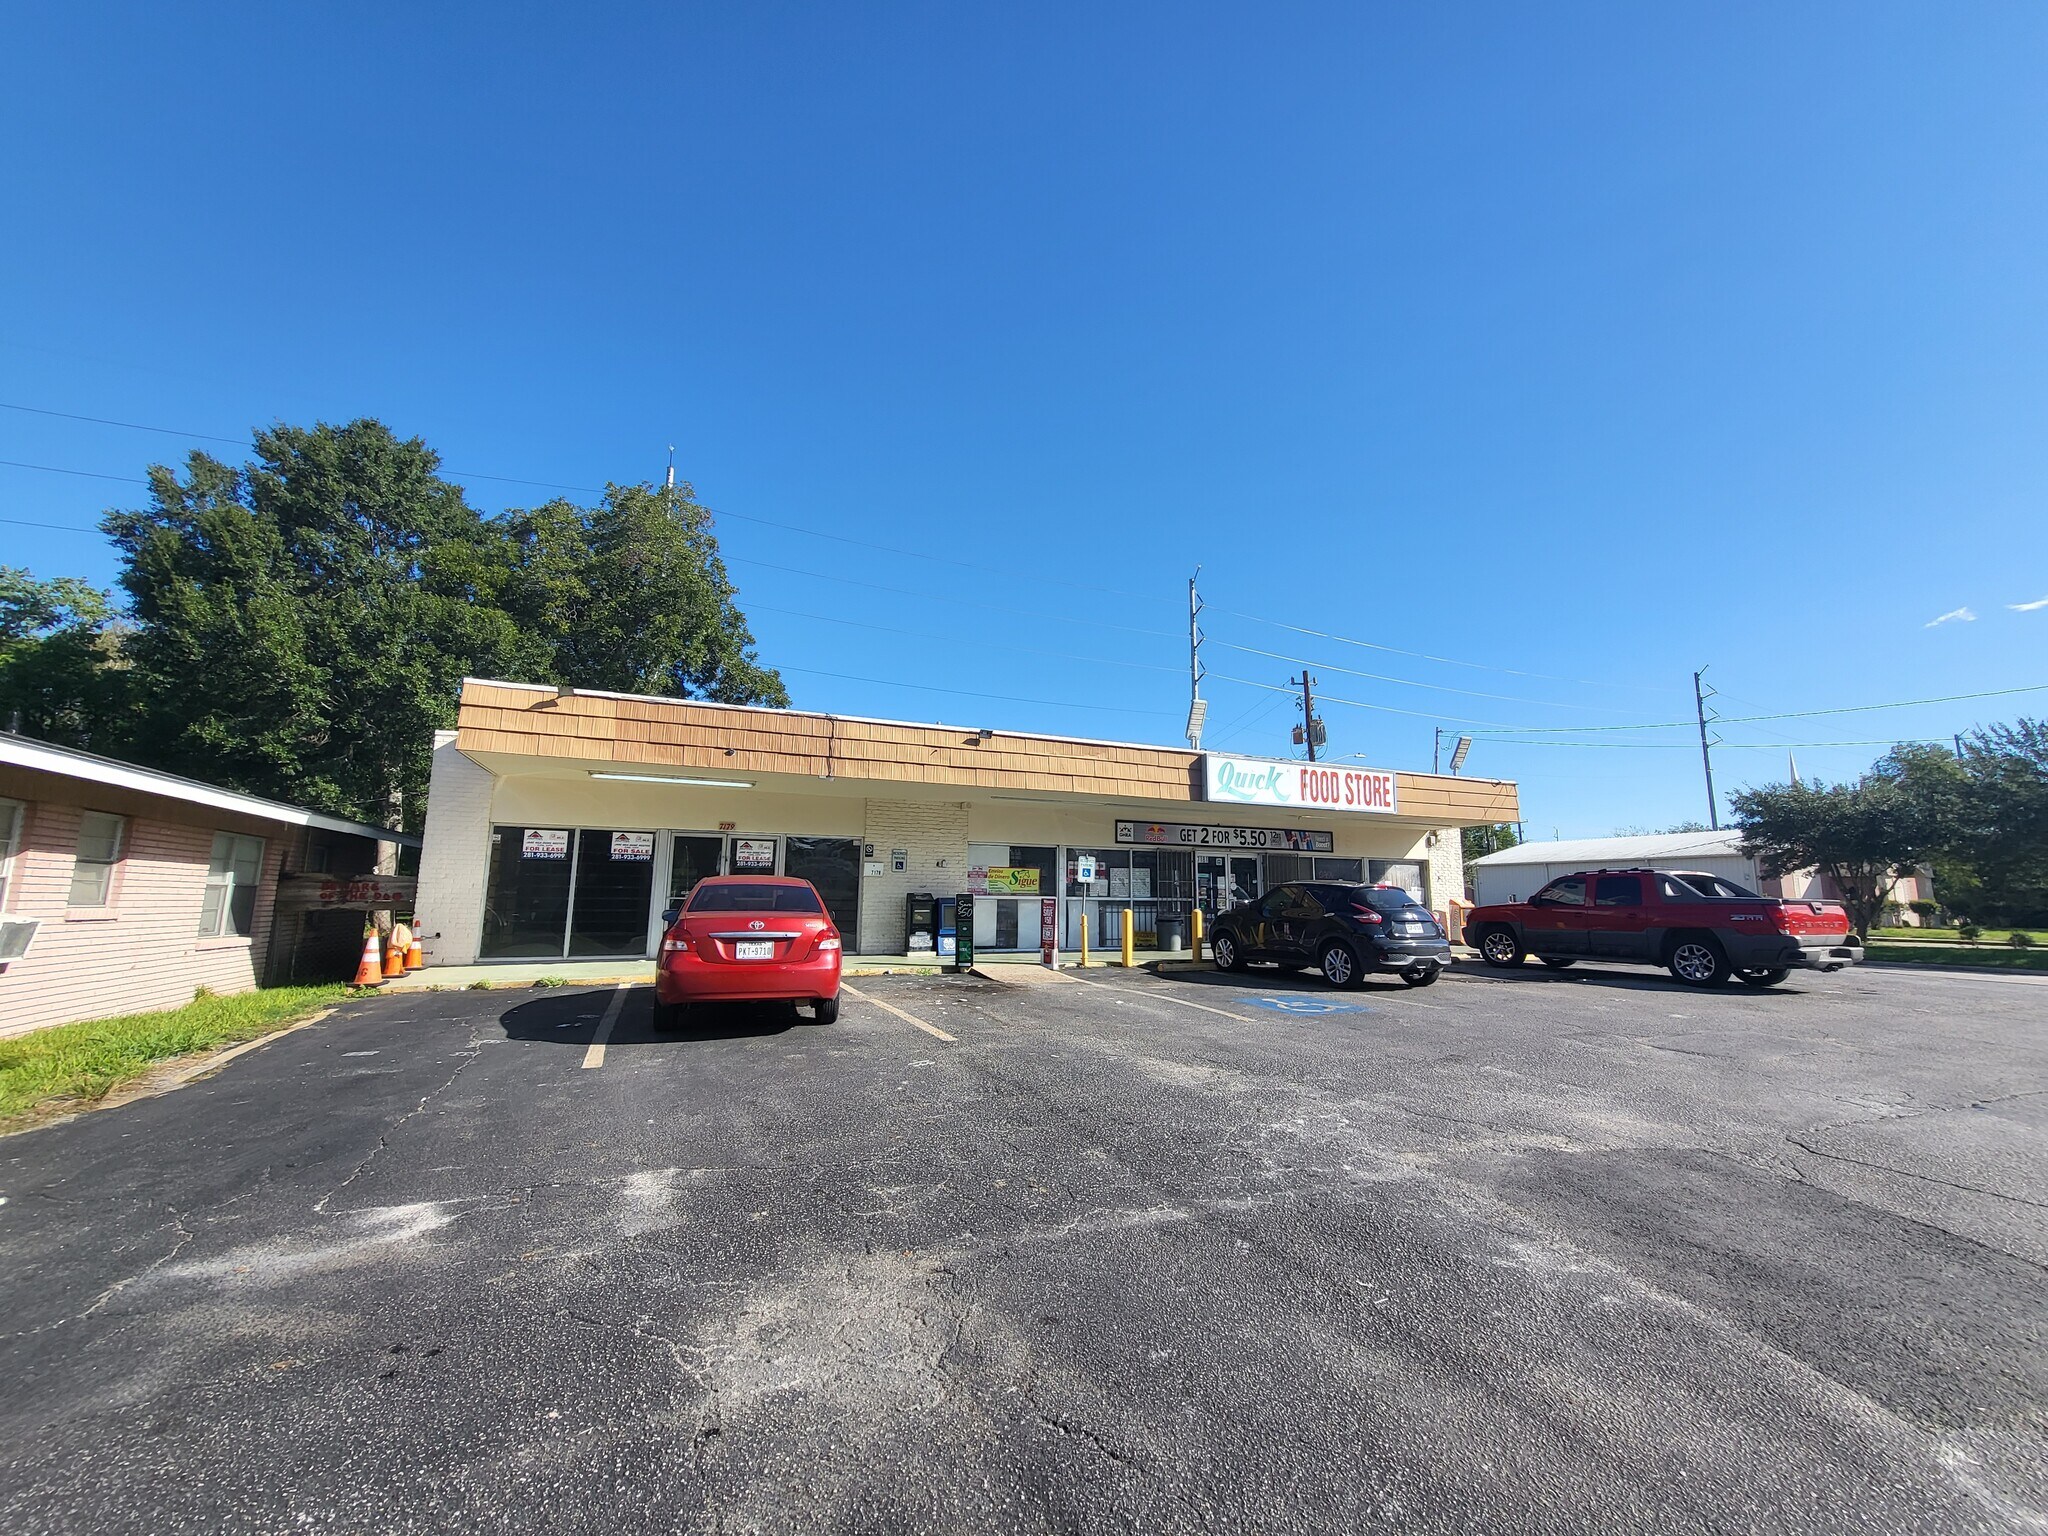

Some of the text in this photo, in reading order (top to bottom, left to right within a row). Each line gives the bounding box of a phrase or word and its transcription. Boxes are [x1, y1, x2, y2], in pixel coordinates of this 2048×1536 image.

[1216, 761, 1391, 808] Quick FOOD STORE
[1179, 828, 1267, 847] GET 2 FOR $5.50
[321, 881, 380, 892] BEWARE
[1009, 869, 1038, 888] Sigue
[319, 892, 335, 900] OF
